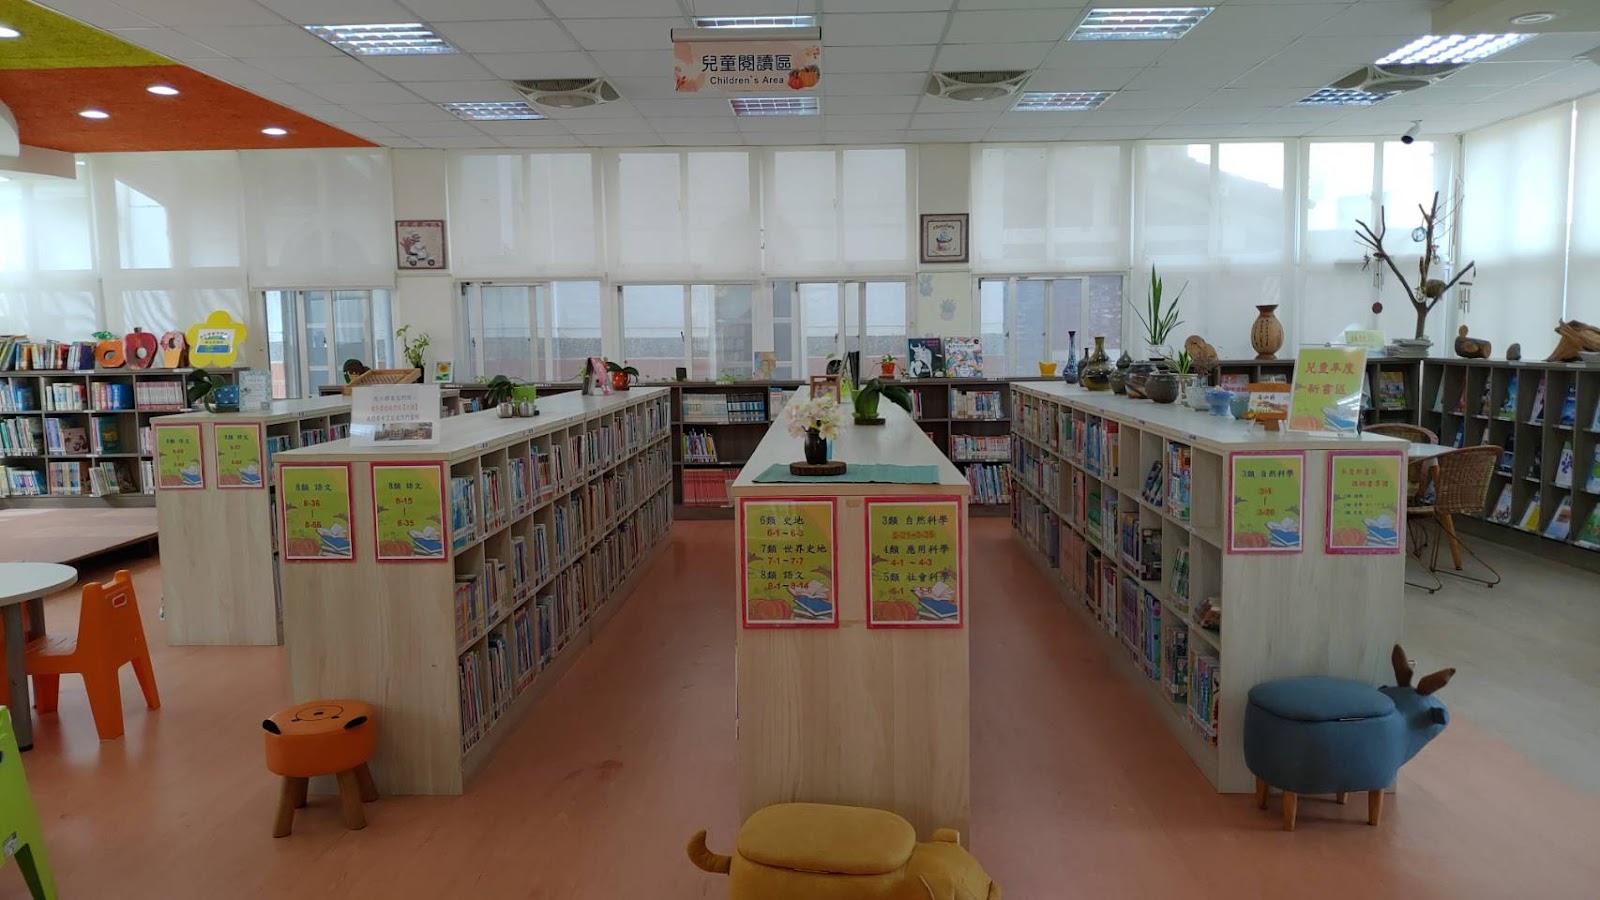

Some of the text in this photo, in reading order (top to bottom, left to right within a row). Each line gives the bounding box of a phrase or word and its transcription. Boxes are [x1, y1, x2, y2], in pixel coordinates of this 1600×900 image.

[701, 54, 792, 72] 兒童閱讀區
[762, 76, 784, 84] Area
[760, 515, 805, 525] 6類 史地
[882, 515, 948, 525] 3類 自然科學
[761, 544, 827, 554] 7類 世界史地
[907, 544, 949, 554] 應用科學
[761, 571, 804, 579] 8類 語文
[908, 572, 950, 581] 社會科學
